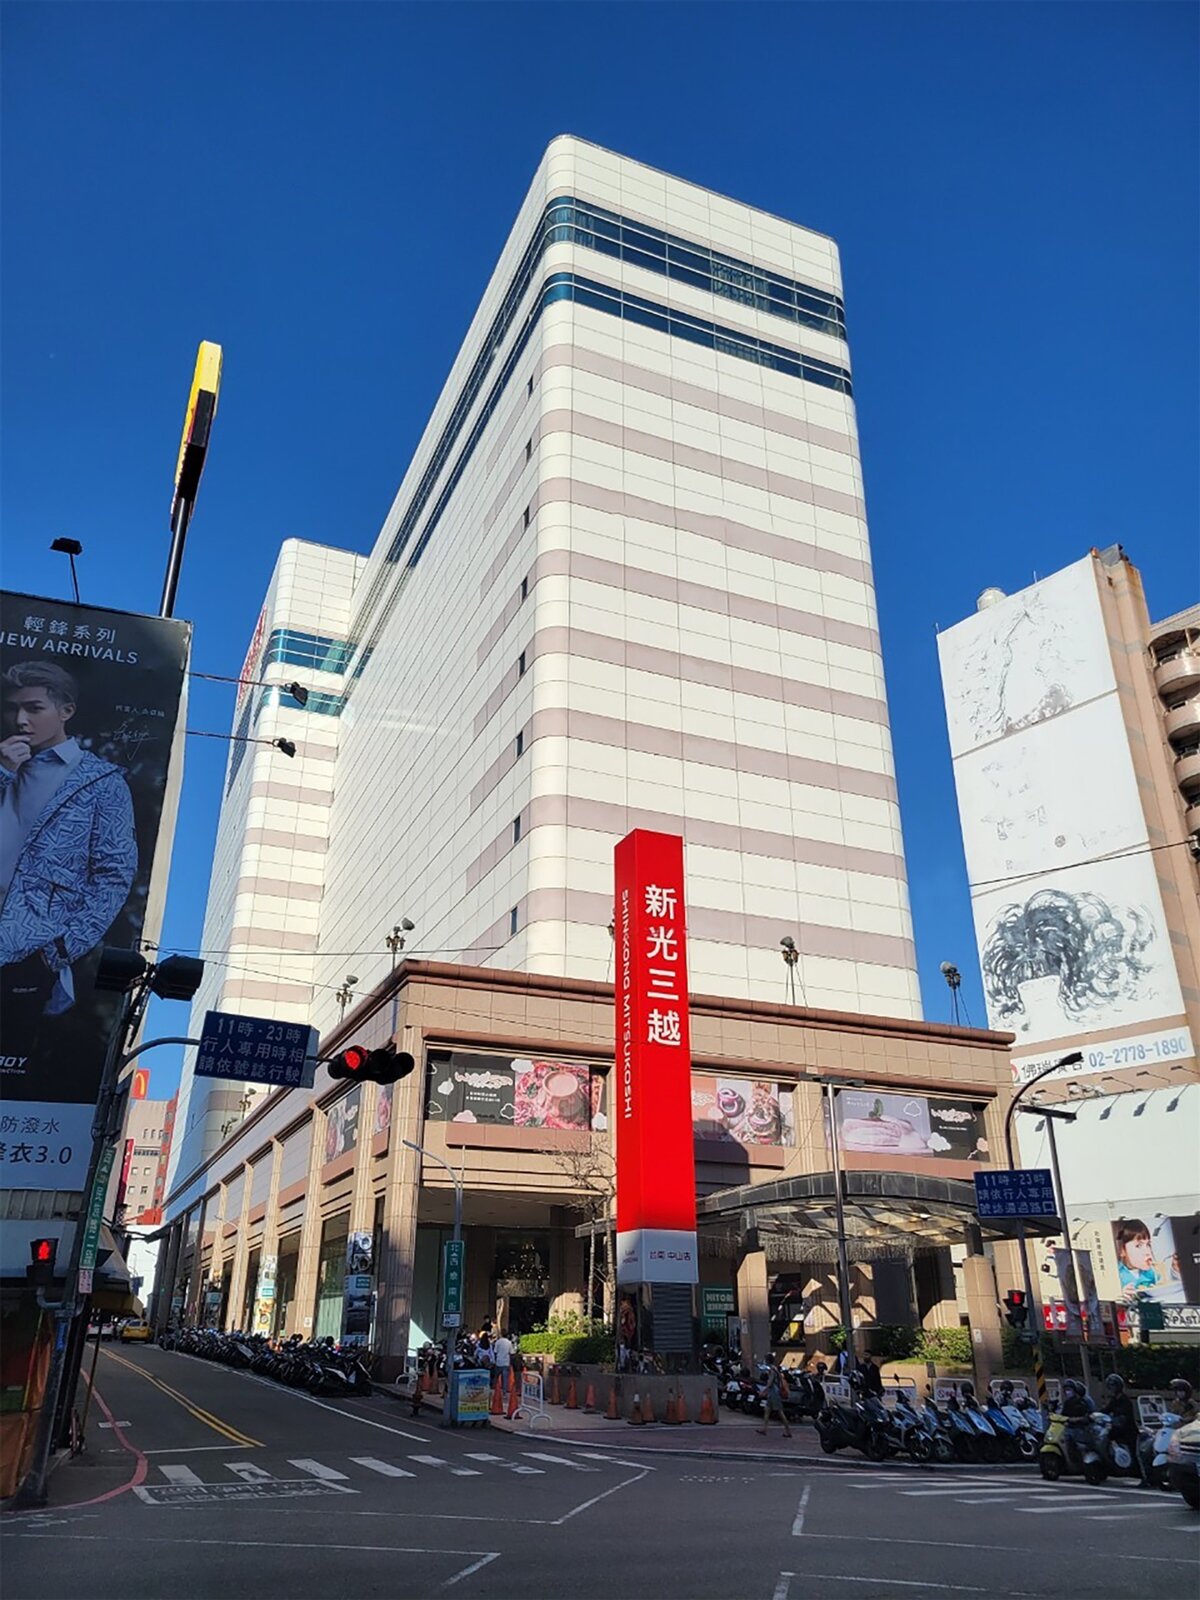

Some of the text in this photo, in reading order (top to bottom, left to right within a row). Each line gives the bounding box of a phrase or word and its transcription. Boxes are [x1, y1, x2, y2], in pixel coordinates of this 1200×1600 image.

[43, 639, 139, 664] ARRIVALS
[645, 884, 681, 1046] 新光三越
[621, 889, 632, 1118] SHINKONG MITSUKOSHI
[202, 1036, 305, 1062] 行人專用時相
[1088, 1036, 1188, 1068] 02-2778-1890
[198, 1055, 300, 1082] 請依號誌行駛
[978, 1187, 1053, 1201] 請依行人專用
